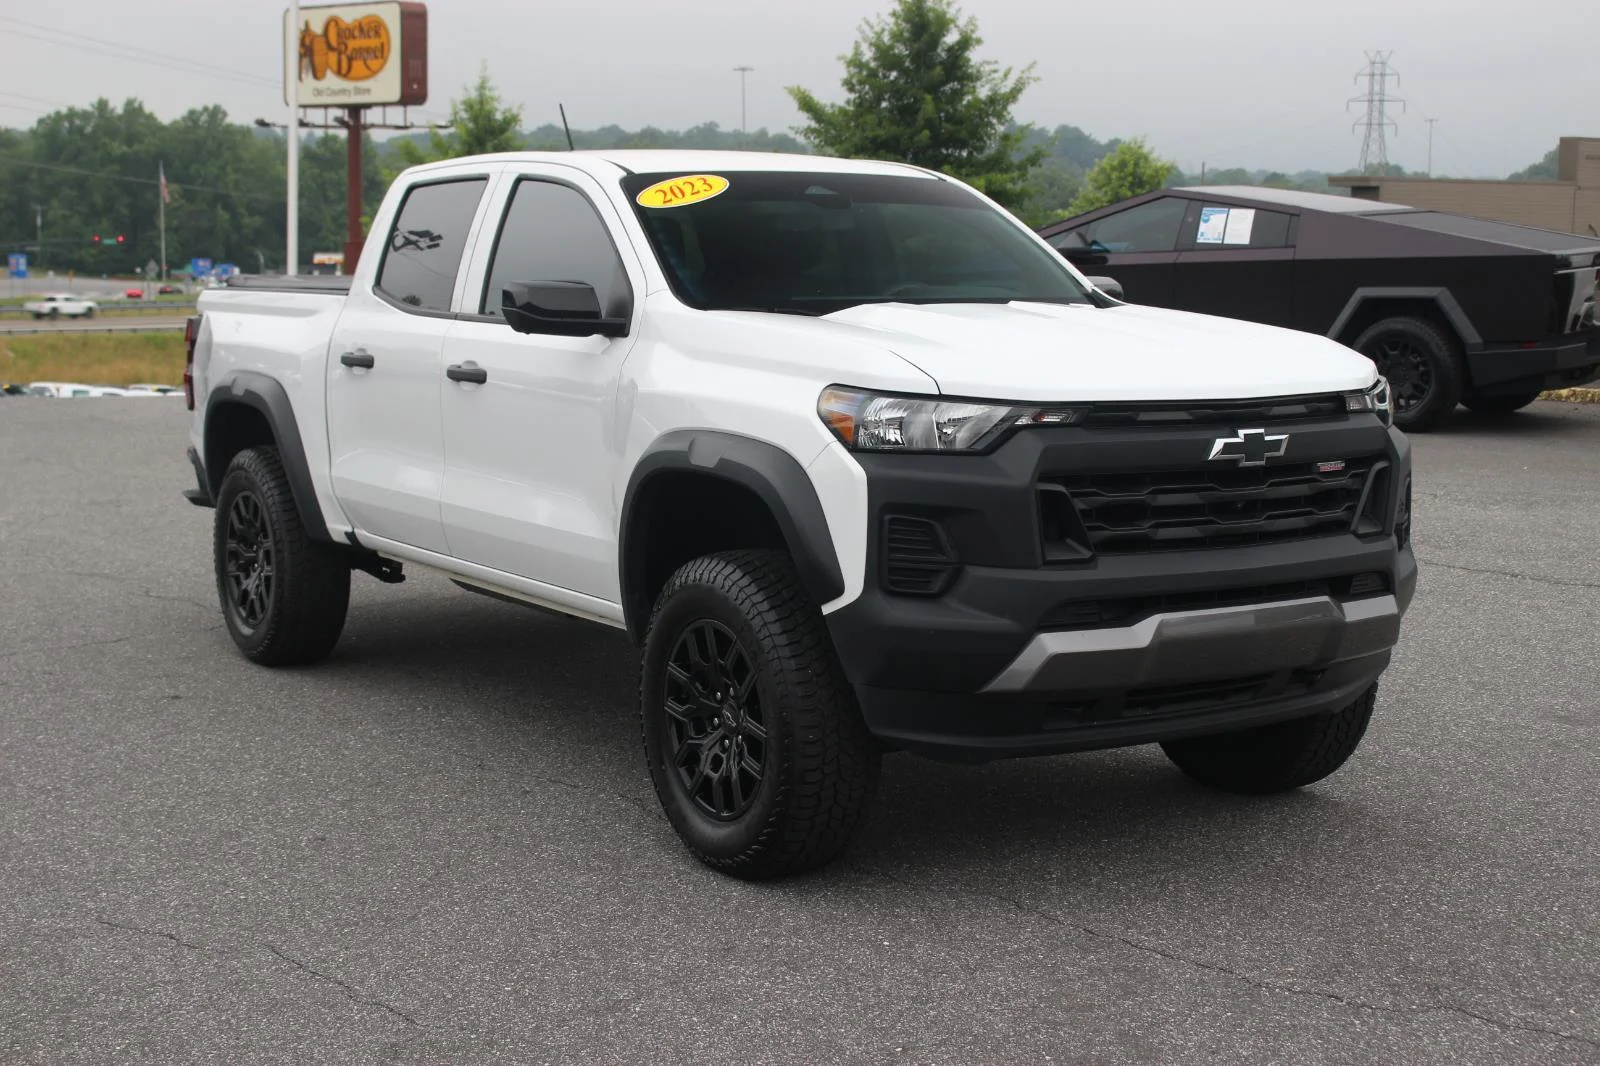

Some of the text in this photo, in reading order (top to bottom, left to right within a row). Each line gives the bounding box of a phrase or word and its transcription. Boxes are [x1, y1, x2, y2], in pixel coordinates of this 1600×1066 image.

[323, 18, 382, 52] Cracker
[337, 41, 385, 78] Barrel
[328, 87, 352, 98] Country
[353, 86, 372, 96] Store
[655, 177, 713, 204] 2023
